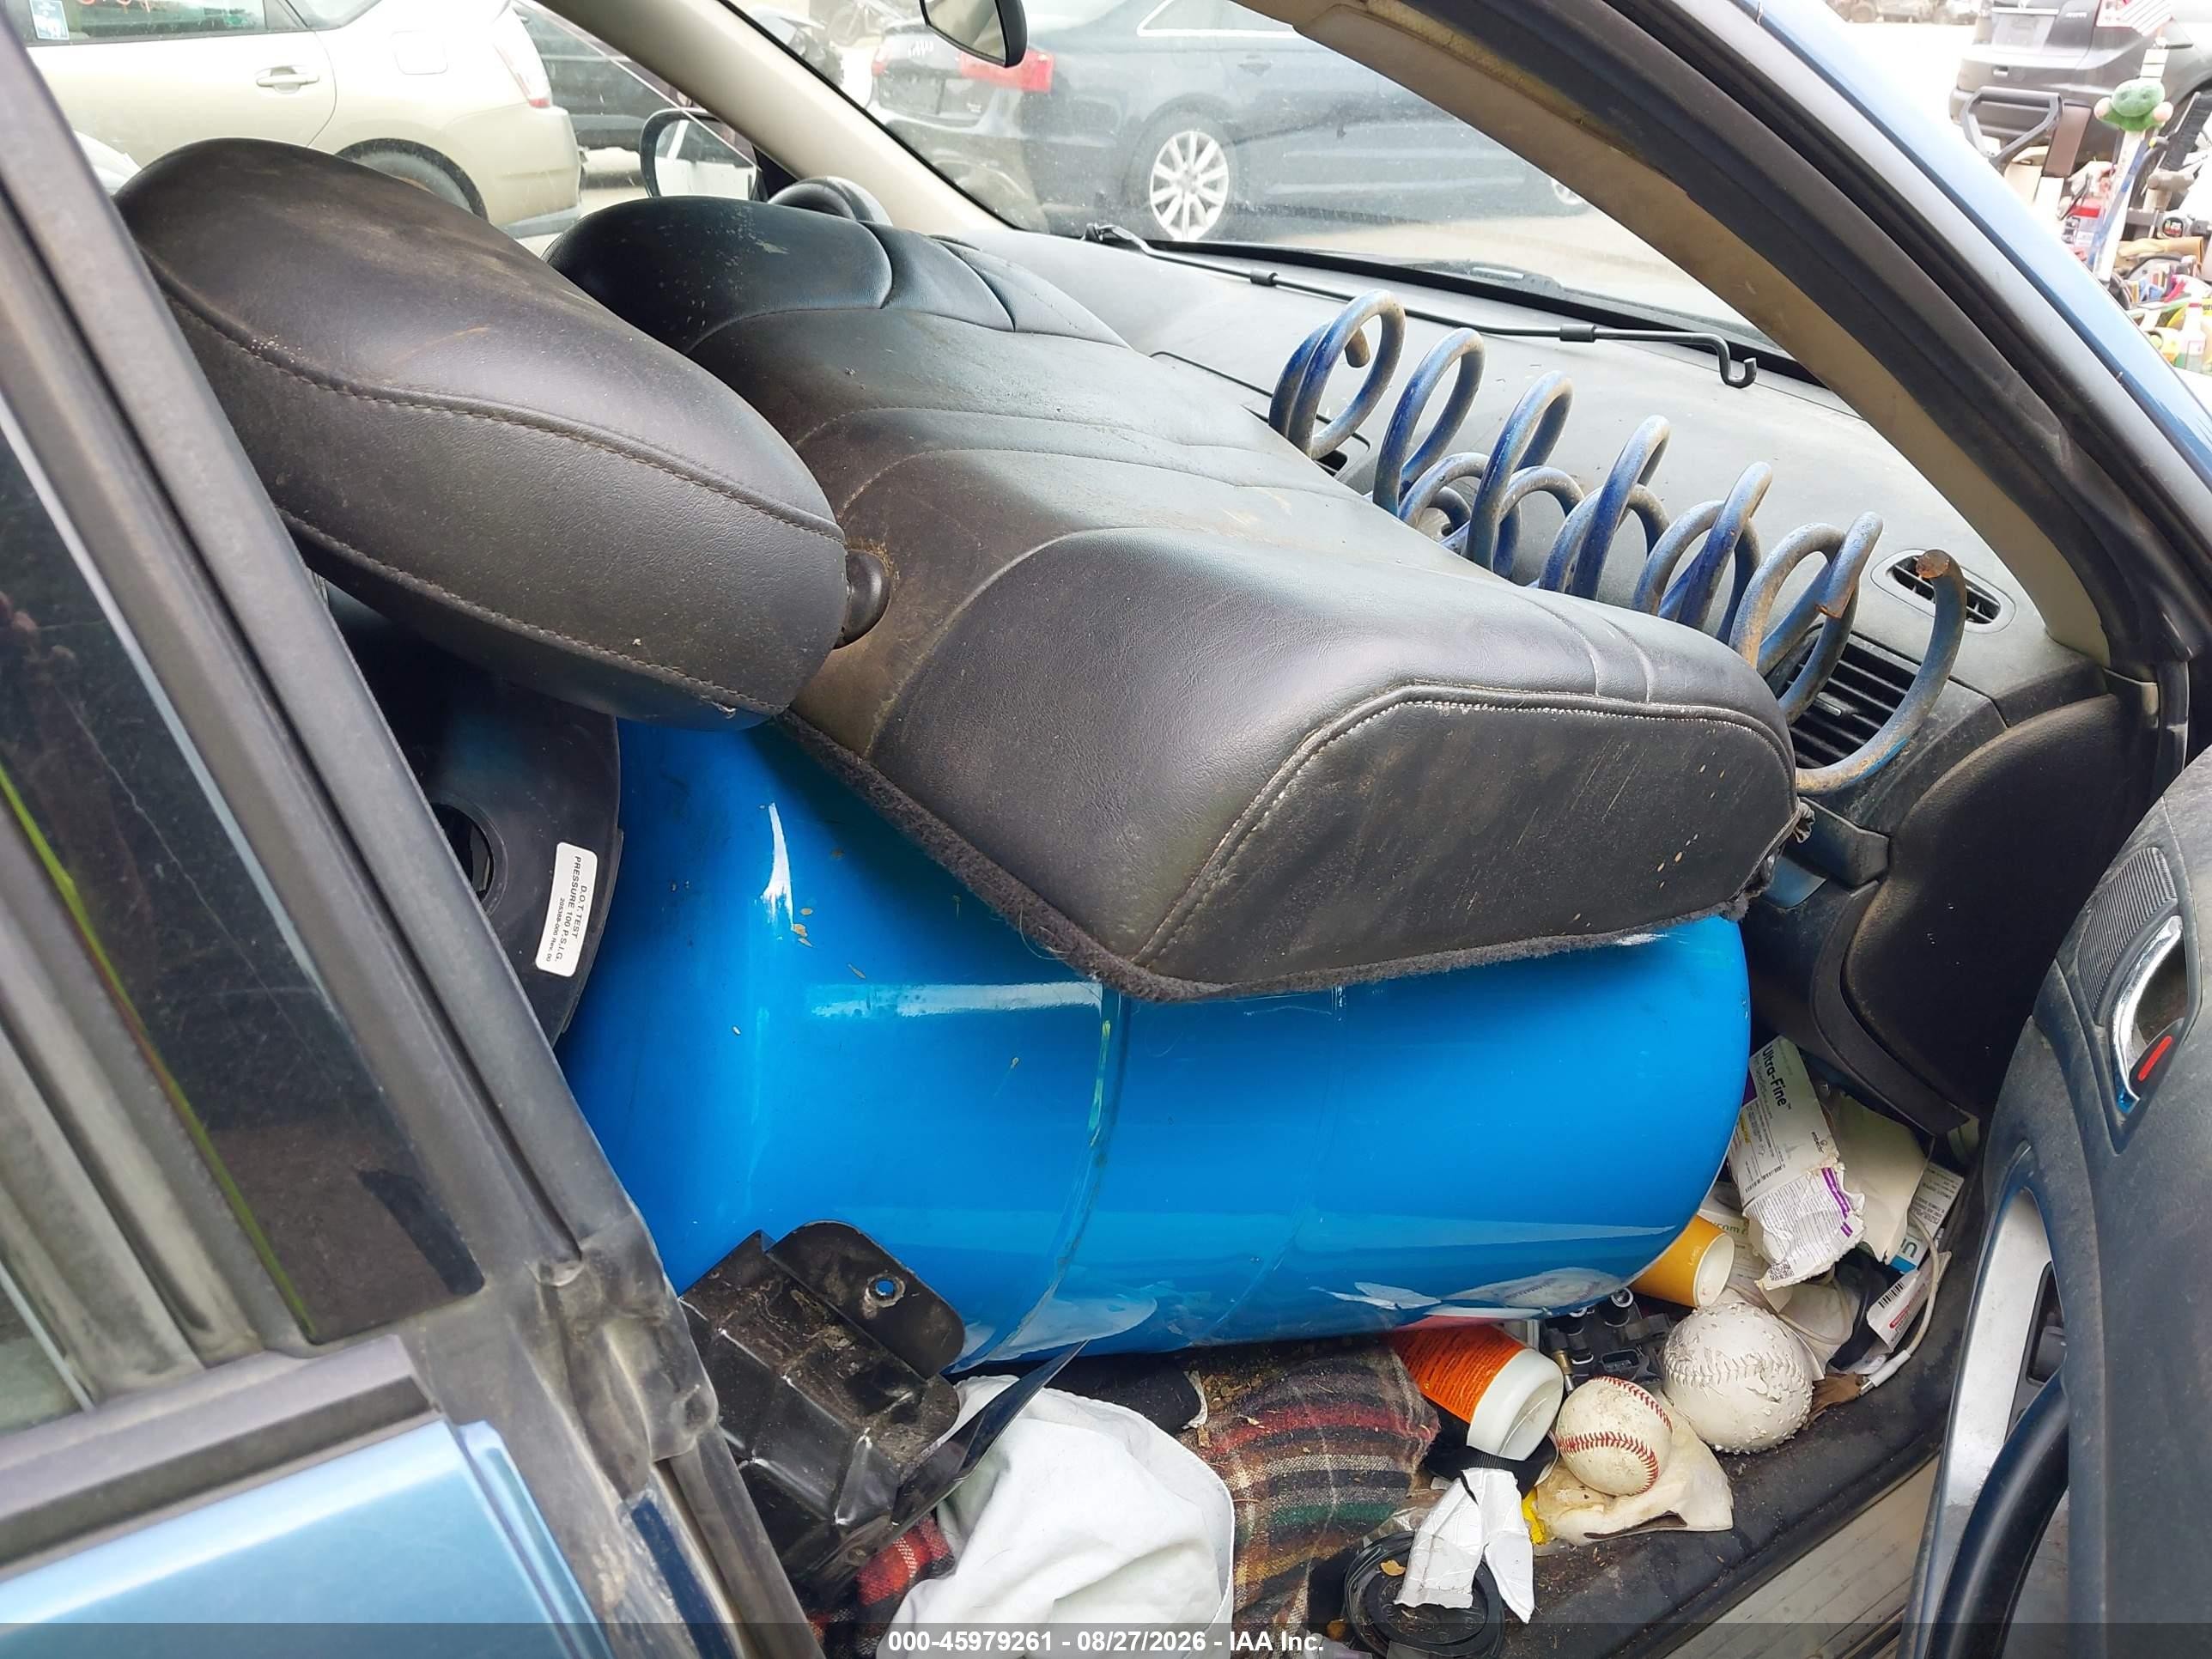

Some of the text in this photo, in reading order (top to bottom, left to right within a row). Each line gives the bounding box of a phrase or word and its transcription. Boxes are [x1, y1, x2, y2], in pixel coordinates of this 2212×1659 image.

[568, 856, 581, 908] PRESSURE
[563, 912, 573, 927] 100
[571, 915, 582, 939] TEST
